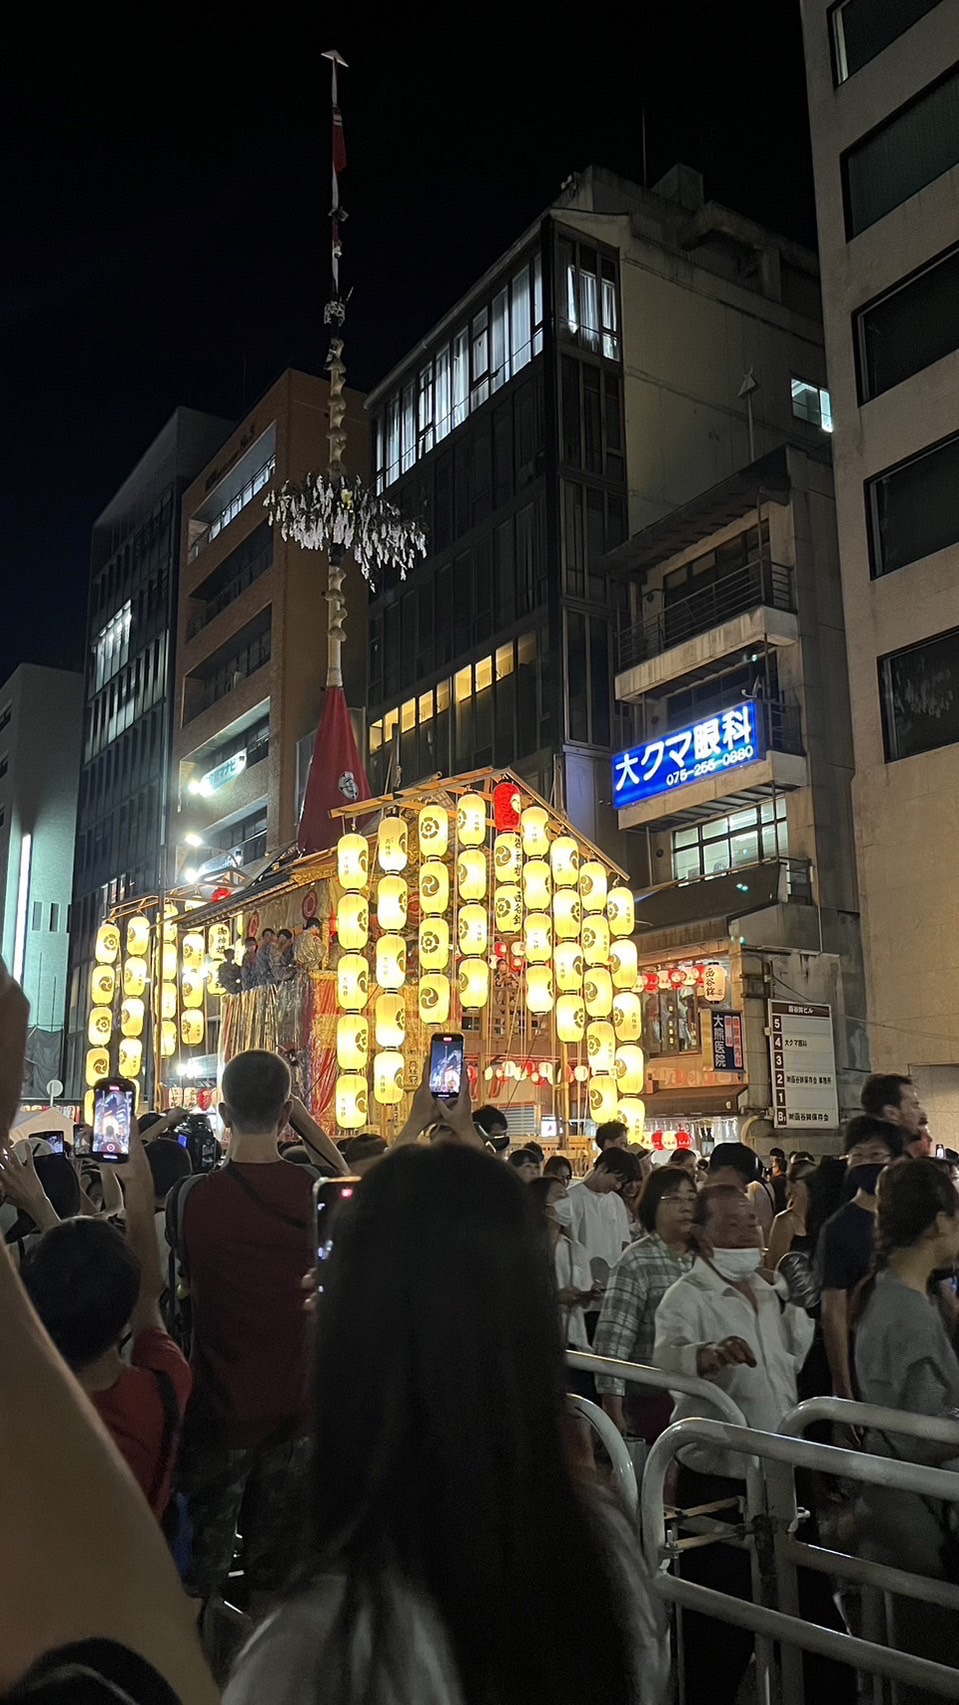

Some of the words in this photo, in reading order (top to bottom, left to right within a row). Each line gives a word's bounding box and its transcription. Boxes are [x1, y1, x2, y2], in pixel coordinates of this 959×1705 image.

[615, 705, 752, 792] 大クマ眼科
[665, 744, 754, 786] 075-255-0880
[774, 1018, 781, 1029] 5
[713, 1014, 726, 1067] 大熊医院
[774, 1037, 781, 1047] 4
[775, 1055, 782, 1066] 3
[776, 1074, 783, 1084] 2
[778, 1092, 784, 1103] 1
[777, 1111, 786, 1122] B1
